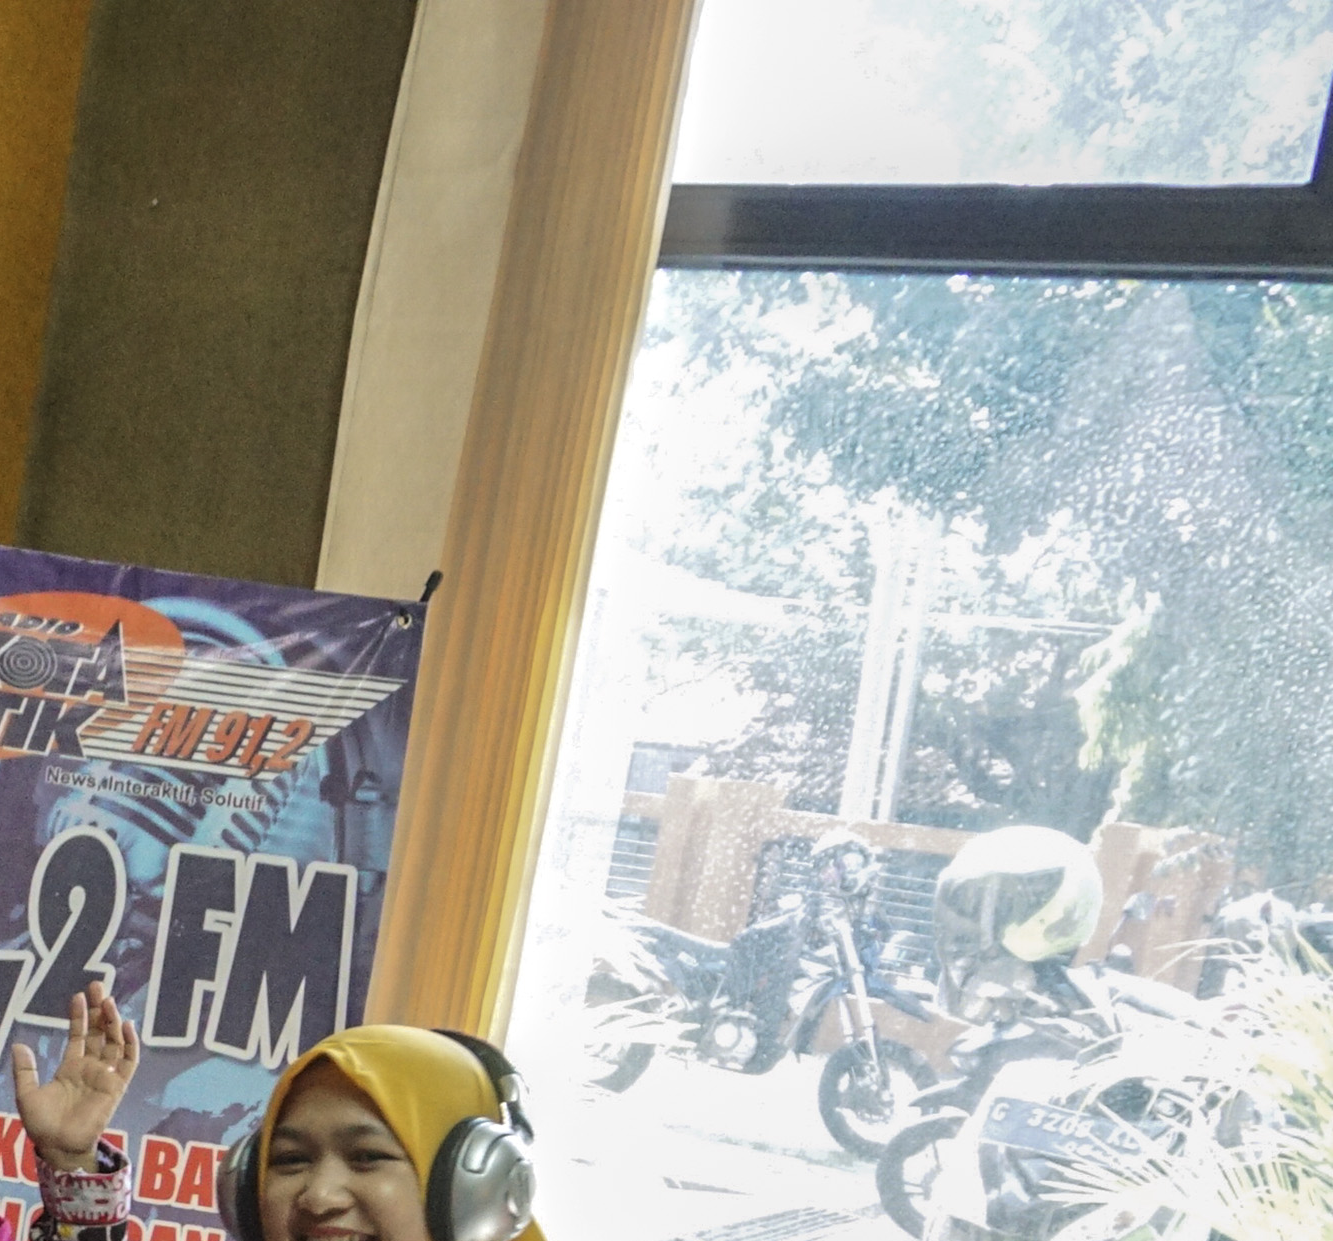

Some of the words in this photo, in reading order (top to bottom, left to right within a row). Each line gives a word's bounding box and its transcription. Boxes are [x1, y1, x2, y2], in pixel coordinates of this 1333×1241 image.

[132, 700, 217, 760] FM
[205, 709, 315, 777] 91,2
[201, 788, 266, 811] Solutif
[143, 842, 359, 1070] FM
